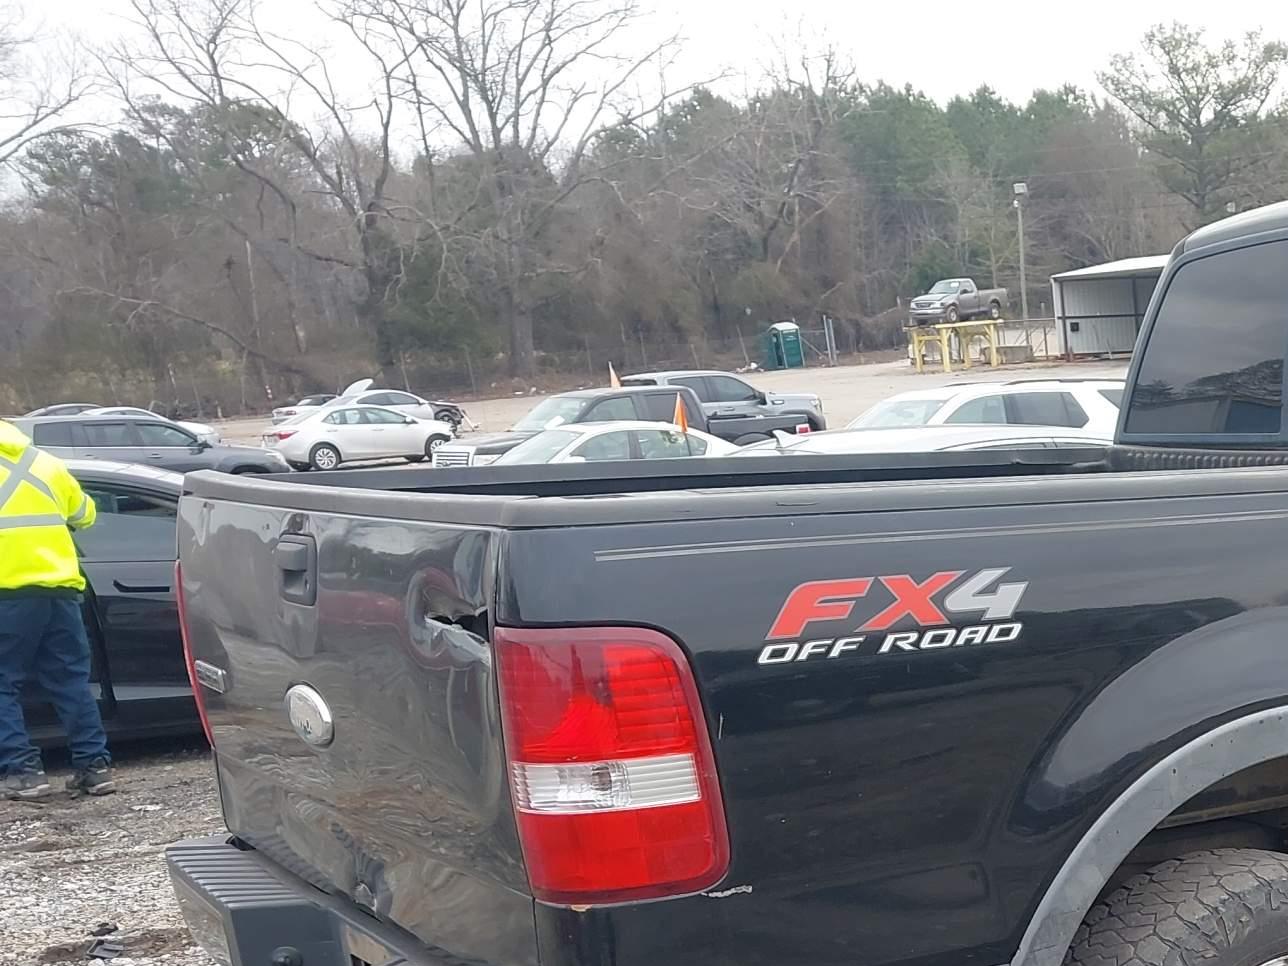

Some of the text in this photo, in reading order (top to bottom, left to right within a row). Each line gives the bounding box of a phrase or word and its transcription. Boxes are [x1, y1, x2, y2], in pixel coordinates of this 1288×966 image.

[764, 567, 1029, 640] FX4
[758, 622, 1023, 665] OFF ROAD
